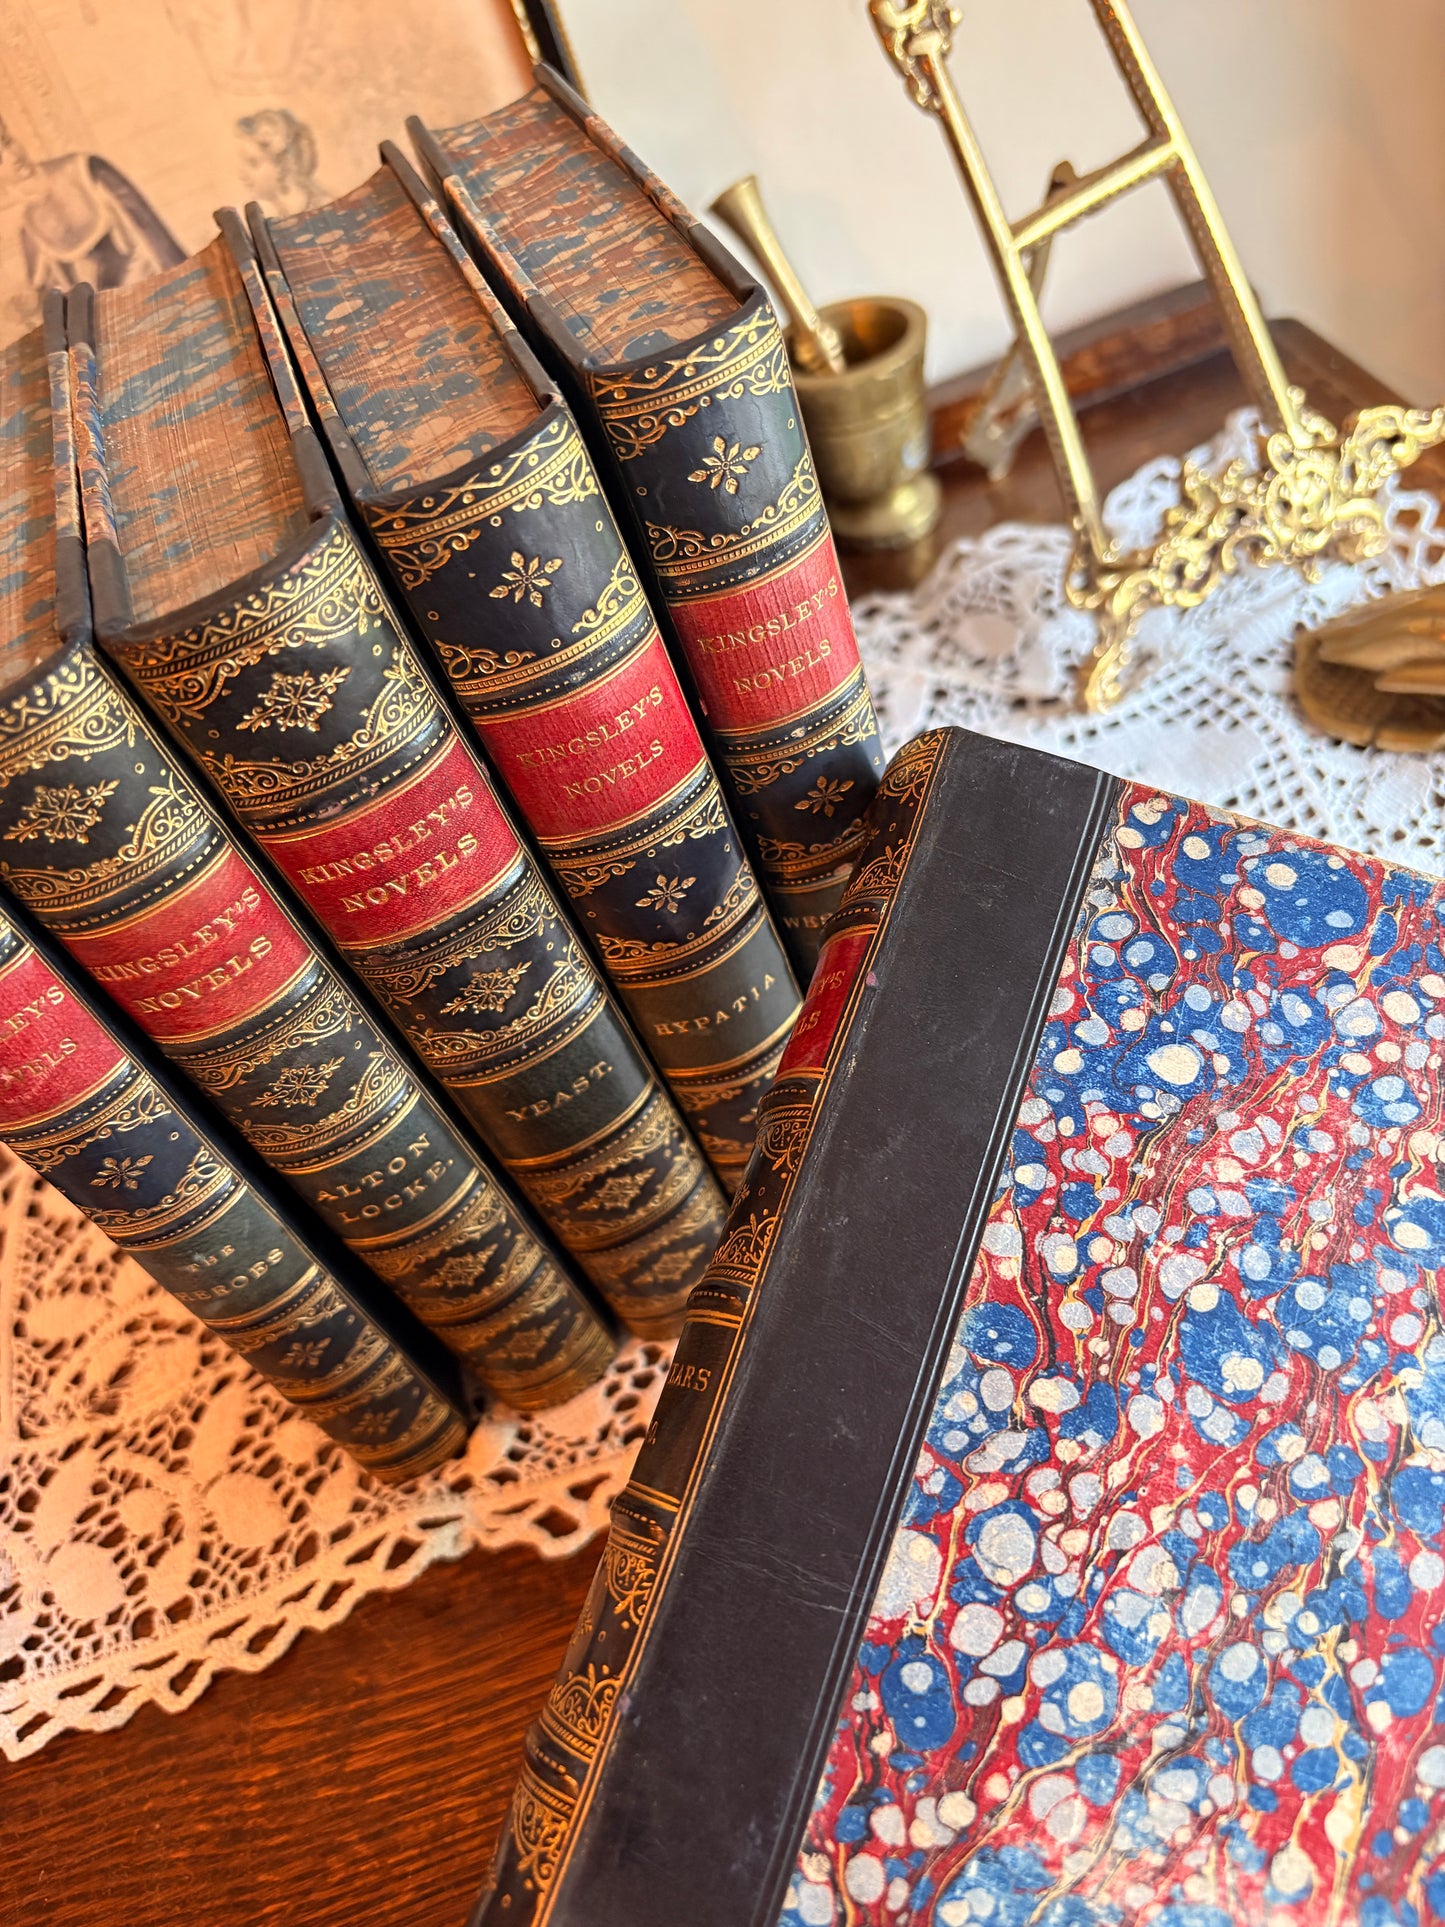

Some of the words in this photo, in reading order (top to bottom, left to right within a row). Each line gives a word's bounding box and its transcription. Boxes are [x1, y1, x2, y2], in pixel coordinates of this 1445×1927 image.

[697, 577, 839, 653] KINGSLEY'S
[733, 638, 832, 695] NOVELS
[516, 685, 664, 768] KINGSLEY'S
[562, 738, 664, 800] NOVELS
[297, 784, 474, 885] KINGSLEY'S
[339, 832, 479, 913] NOVELS
[87, 886, 261, 982] KINGSLEY'S
[132, 935, 273, 1014] NOVELS
[653, 973, 776, 1036] HYPATIA
[505, 1059, 614, 1123] YEAST.
[317, 1131, 431, 1202] ALTON
[337, 1158, 455, 1224] LOCKE.
